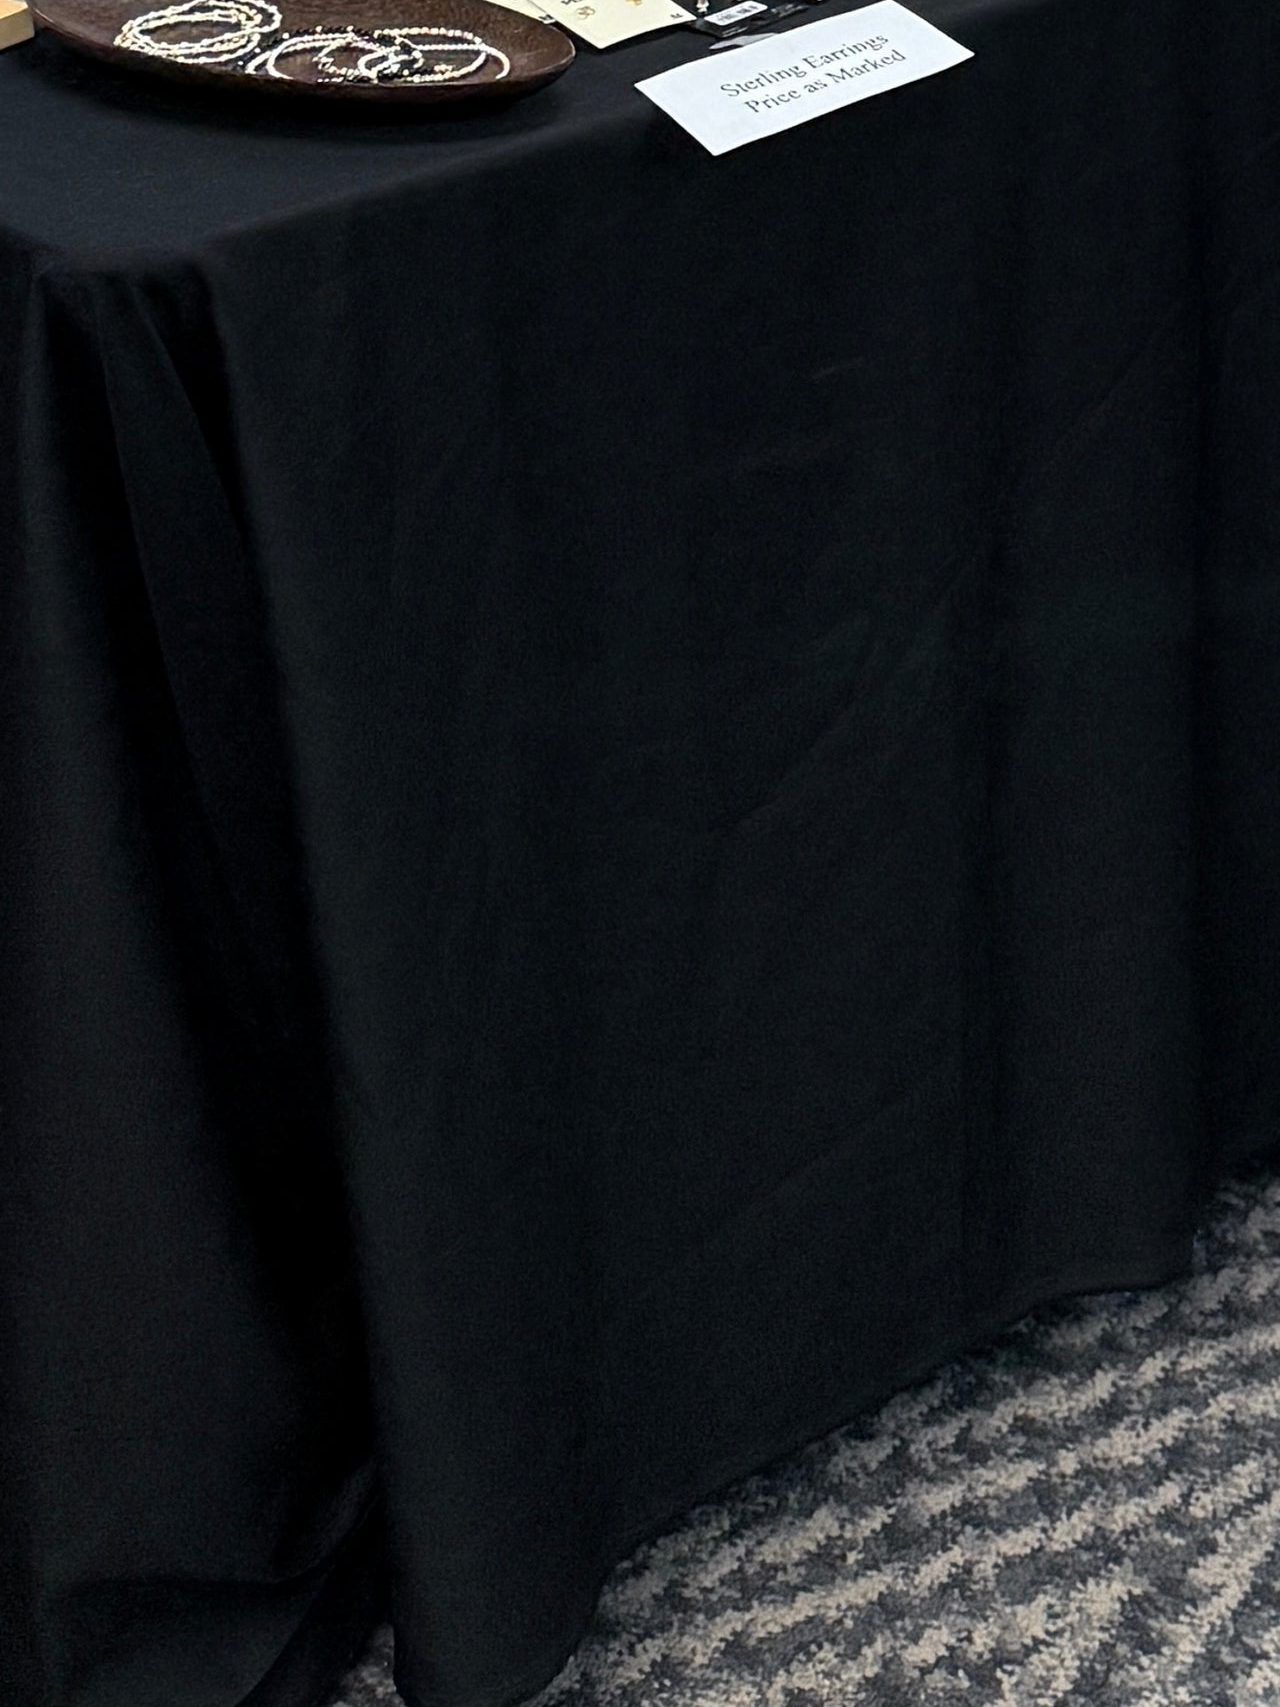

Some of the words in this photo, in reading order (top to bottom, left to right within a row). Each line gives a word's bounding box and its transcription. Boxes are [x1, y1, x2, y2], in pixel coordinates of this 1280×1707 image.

[720, 62, 801, 98] Sterling
[802, 33, 890, 70] Earrings
[744, 88, 801, 114] Price
[803, 77, 829, 94] as
[827, 49, 907, 85] Marked
